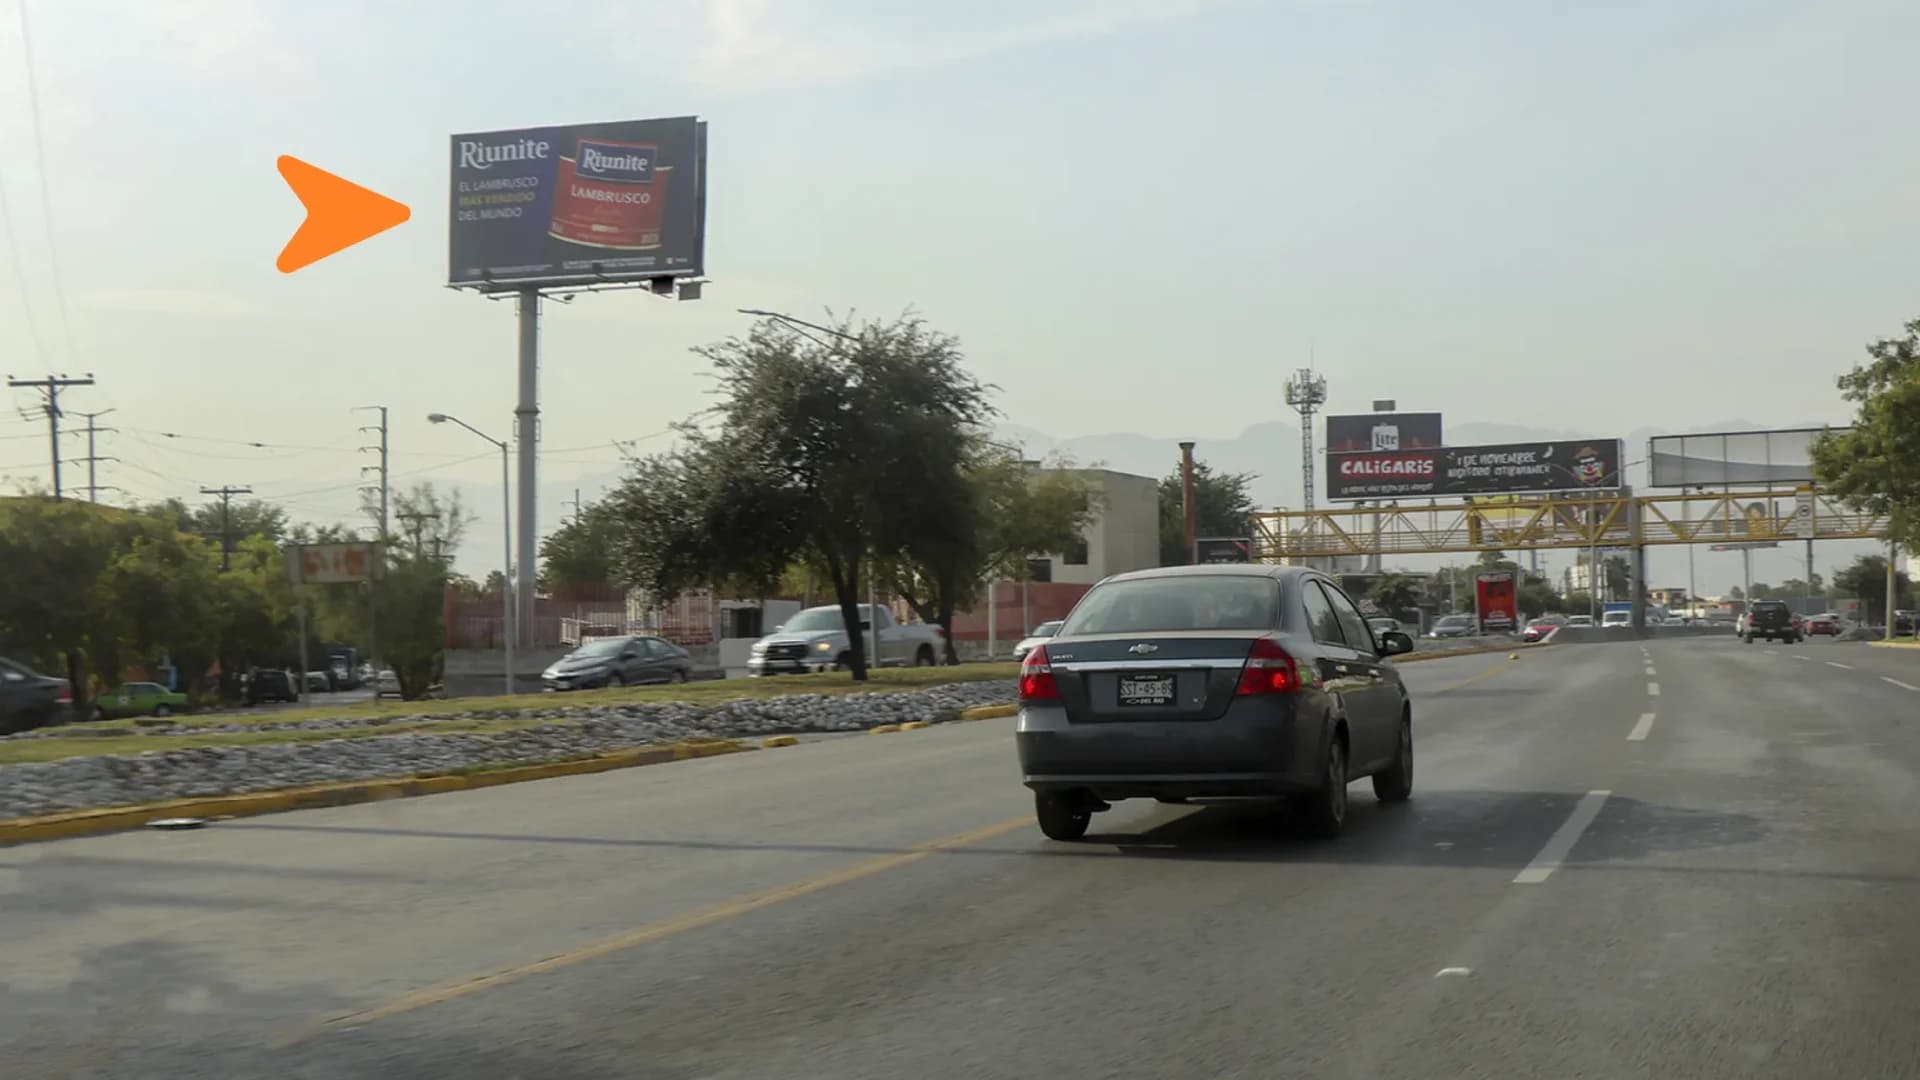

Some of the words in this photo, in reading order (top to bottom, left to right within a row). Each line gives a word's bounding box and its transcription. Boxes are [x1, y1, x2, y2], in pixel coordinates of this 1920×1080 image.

[459, 139, 549, 170] Riunite
[581, 147, 649, 172] Riunite
[459, 181, 471, 192] EL
[473, 176, 539, 191] LAMBRUSCO
[571, 184, 651, 204] LAMBRUSCO
[458, 209, 479, 221] DEL
[481, 207, 523, 219] MUNDO
